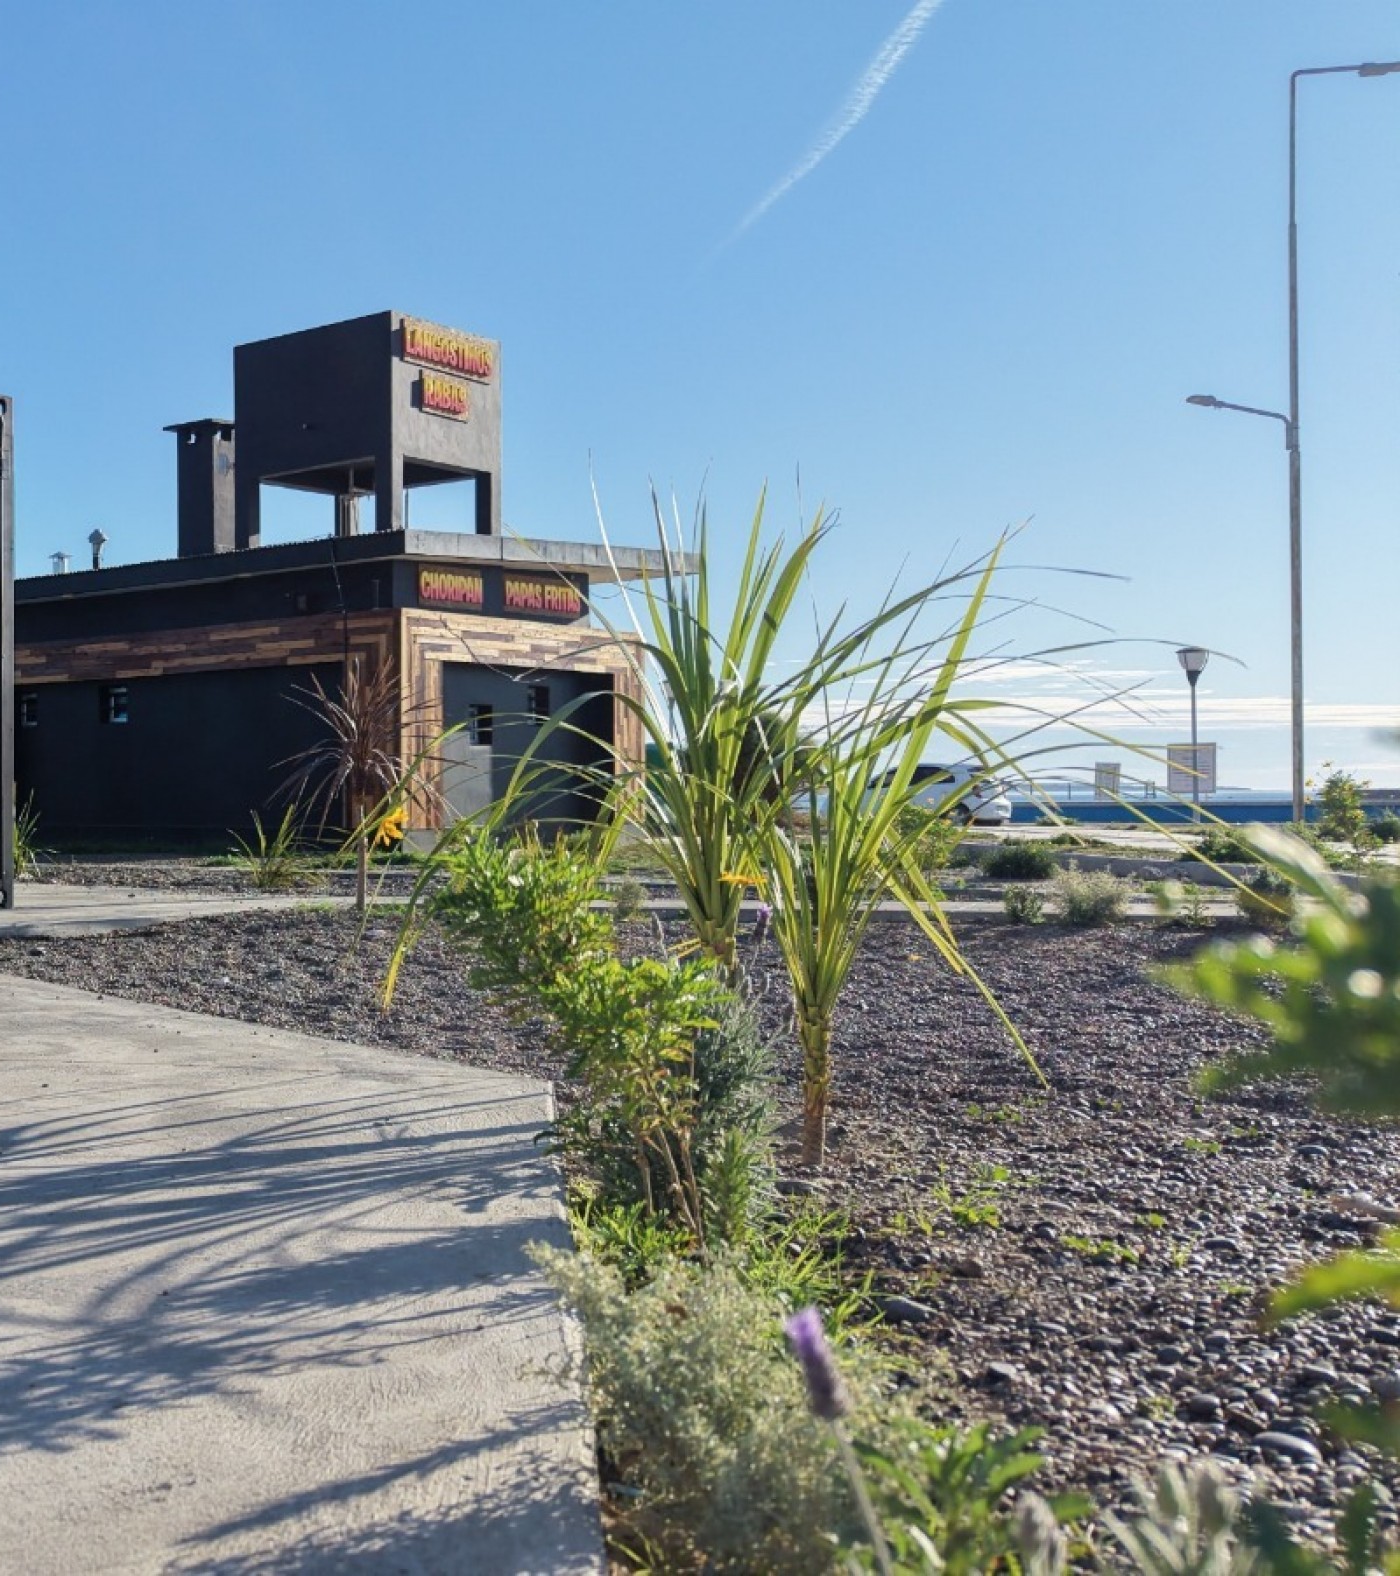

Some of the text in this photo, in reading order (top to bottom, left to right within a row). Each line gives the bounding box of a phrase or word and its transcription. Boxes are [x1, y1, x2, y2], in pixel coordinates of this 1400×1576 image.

[421, 570, 484, 604] CHORIPAN
[505, 580, 581, 613] PAPAS FRITAS
